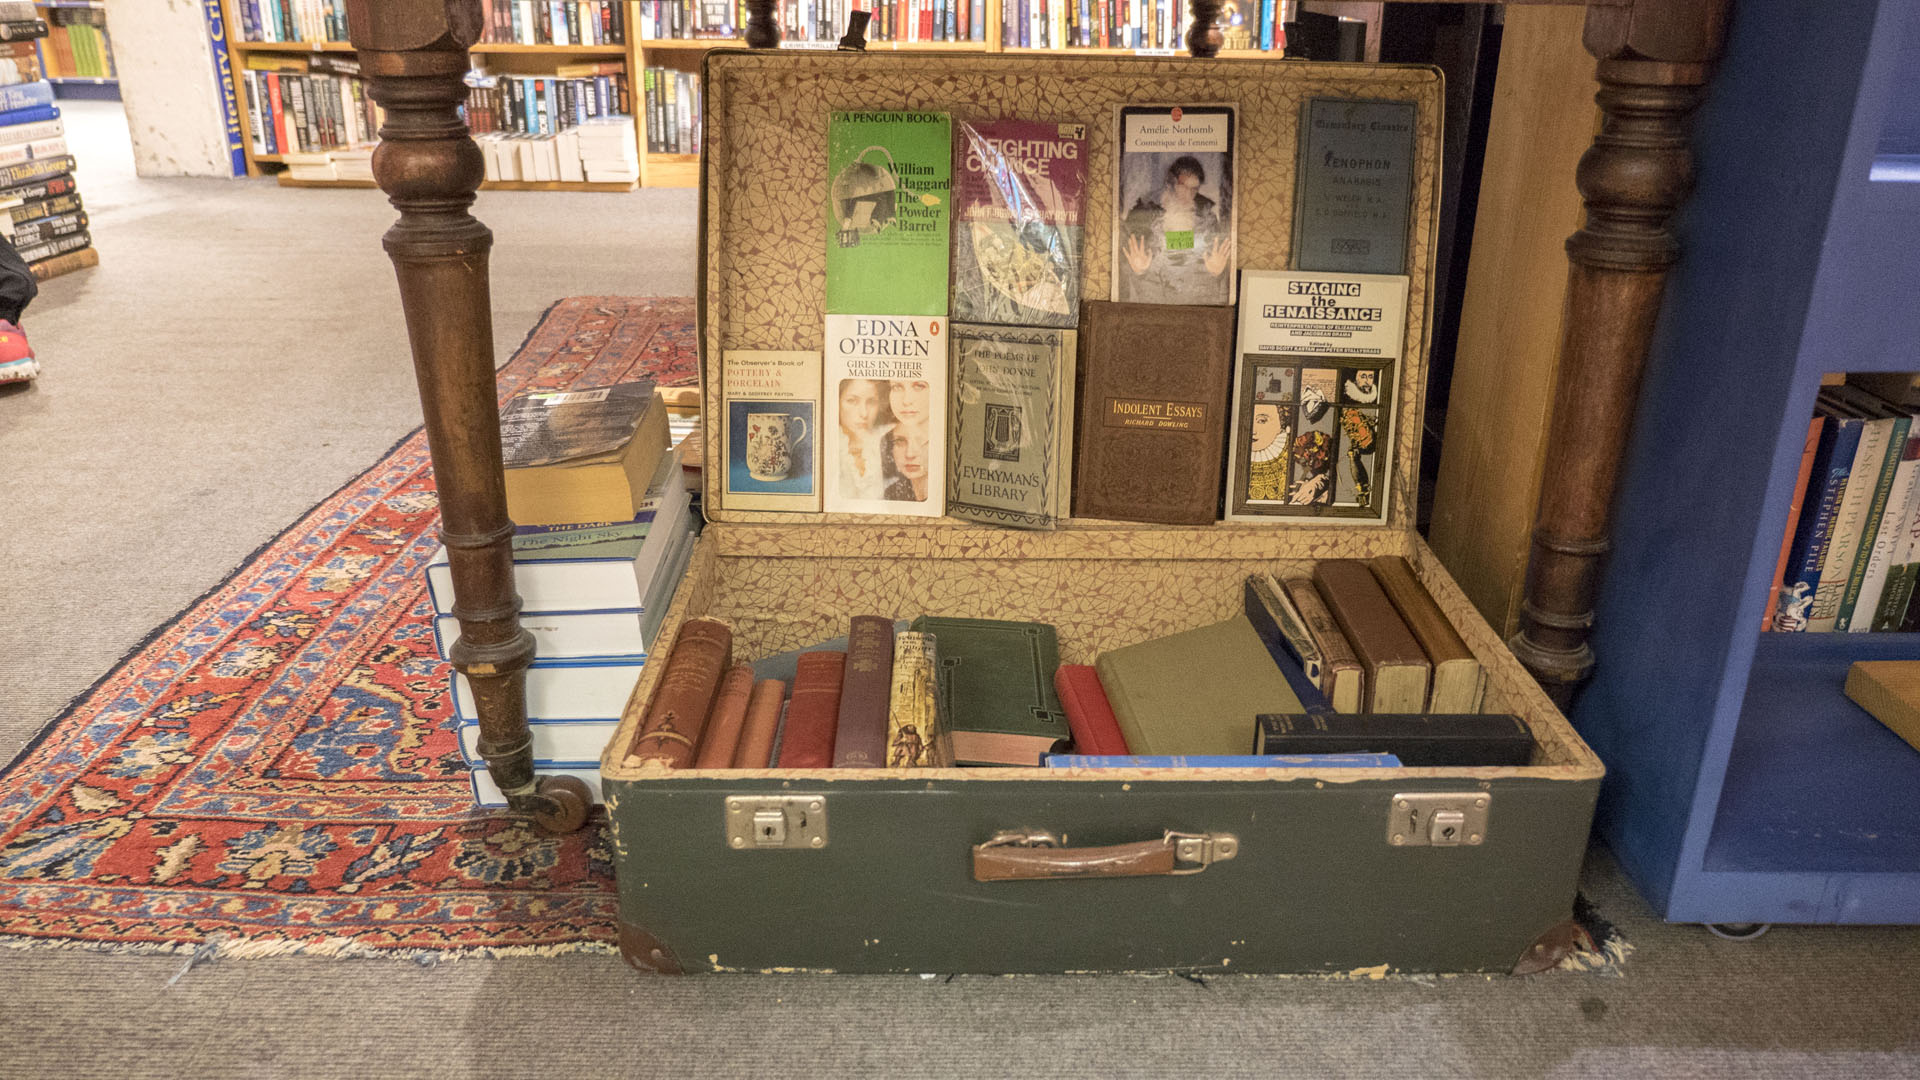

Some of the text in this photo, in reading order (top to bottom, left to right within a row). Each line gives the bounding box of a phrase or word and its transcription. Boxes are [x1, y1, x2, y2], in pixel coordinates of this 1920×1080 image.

[217, 49, 242, 150] Literary
[843, 113, 941, 123] A PENGUIN BOOK
[1140, 125, 1214, 134] Amélie Nothomb
[986, 139, 1078, 160] FIGHTING
[1135, 138, 1176, 148] Cosmétique
[888, 162, 934, 175] William
[966, 155, 1050, 176] CNCE
[898, 178, 950, 192] Haggard
[896, 191, 920, 203] The
[899, 206, 942, 217] Powder
[899, 220, 936, 232] Barrel
[1289, 282, 1360, 296] STAGING
[1311, 296, 1336, 307] the
[1264, 305, 1382, 321] RENAISSANCE
[857, 319, 919, 337] EDNA
[840, 338, 930, 356] O'BRIEN
[975, 350, 1040, 363] THE POEMS OF
[847, 360, 923, 370] GIRLS IN THEIR
[1003, 366, 1036, 377] DONNE
[849, 369, 922, 378] MARRIED BLISS
[1113, 400, 1203, 418] INDOLENT ESSAYS
[963, 465, 1040, 488] EVERYMAN'S
[972, 482, 1028, 502] LIBRARY
[1836, 478, 1848, 504] RETURN
[1831, 431, 1880, 579] HESKETH PEARSON
[548, 522, 614, 532] THE DARK
[1804, 479, 1838, 573] STEPHEN PILE
[1862, 512, 1880, 548] ACCORDING
[553, 534, 592, 543] Night
[596, 531, 623, 539] Sky
[1866, 511, 1896, 579] Last Orders
